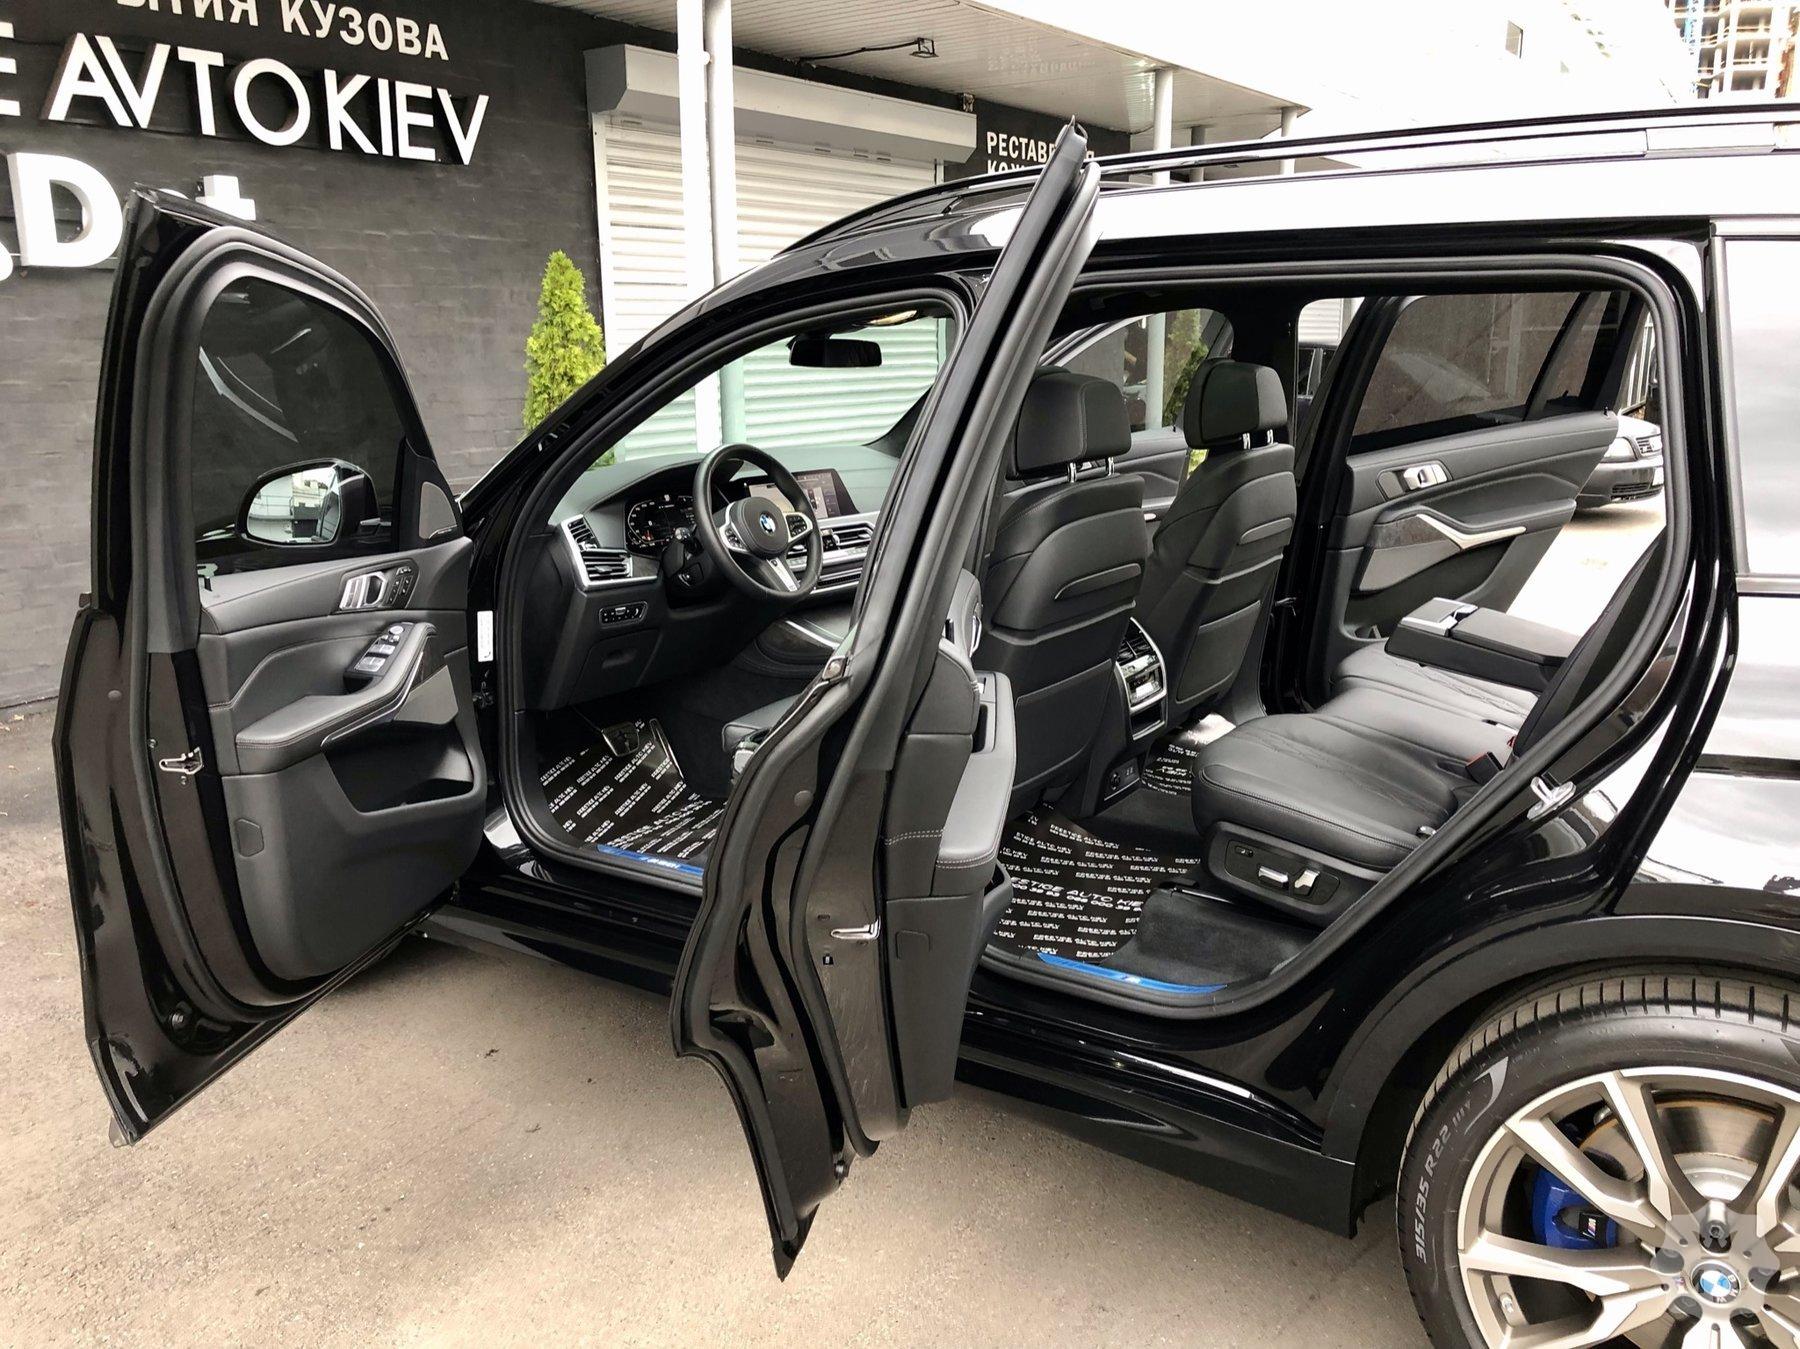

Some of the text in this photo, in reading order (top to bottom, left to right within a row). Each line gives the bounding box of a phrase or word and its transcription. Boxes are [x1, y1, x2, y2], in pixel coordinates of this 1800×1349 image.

[281, 0, 450, 61] КУЗОВА
[1066, 889, 1113, 902] AUTO
[1414, 1176, 1429, 1264] 315/35
[1424, 1124, 1452, 1178] R22
